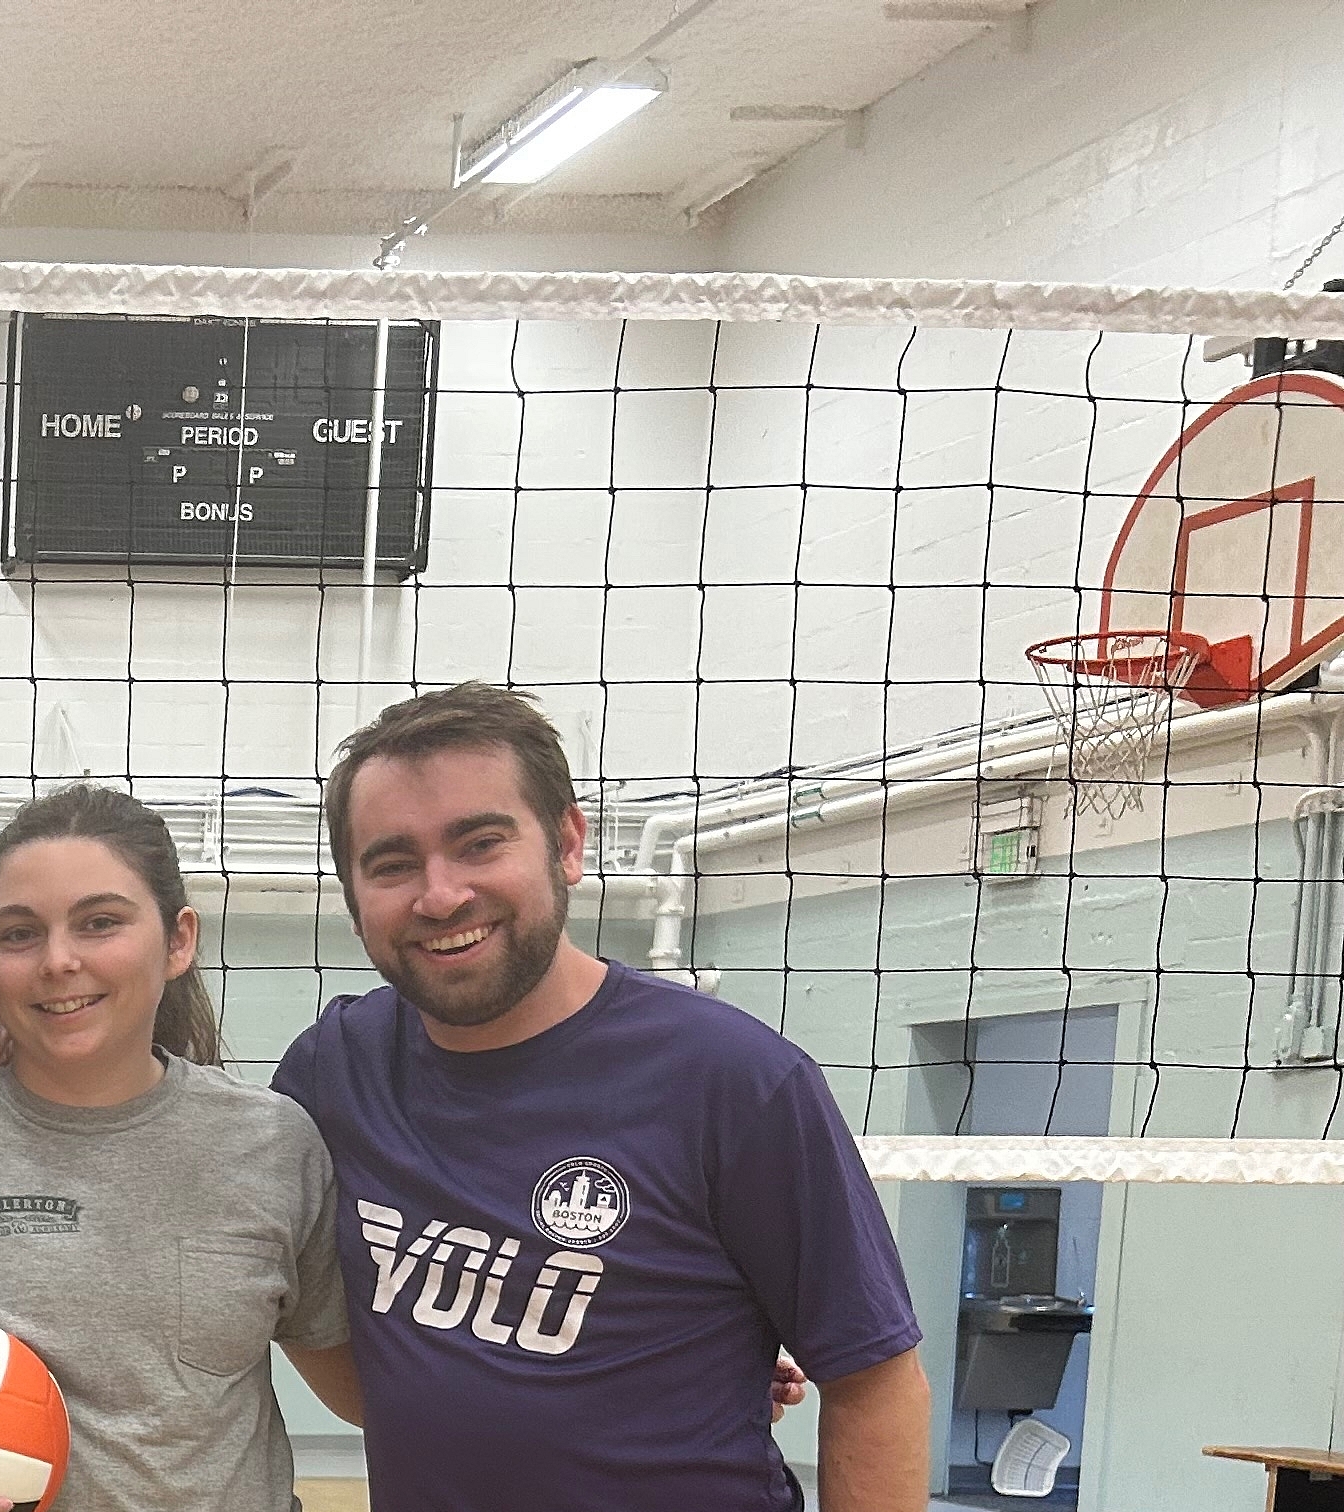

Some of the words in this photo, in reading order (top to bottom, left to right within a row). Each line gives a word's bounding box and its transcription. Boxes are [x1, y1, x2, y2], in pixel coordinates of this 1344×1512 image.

[41, 413, 122, 440] HOME
[312, 418, 403, 445] GUEST
[181, 426, 259, 446] PERIOD
[173, 465, 187, 484] P
[249, 466, 264, 485] P
[180, 502, 254, 522] BONUS
[552, 1209, 602, 1224] BOSTON
[356, 1199, 605, 1356] VOLO
